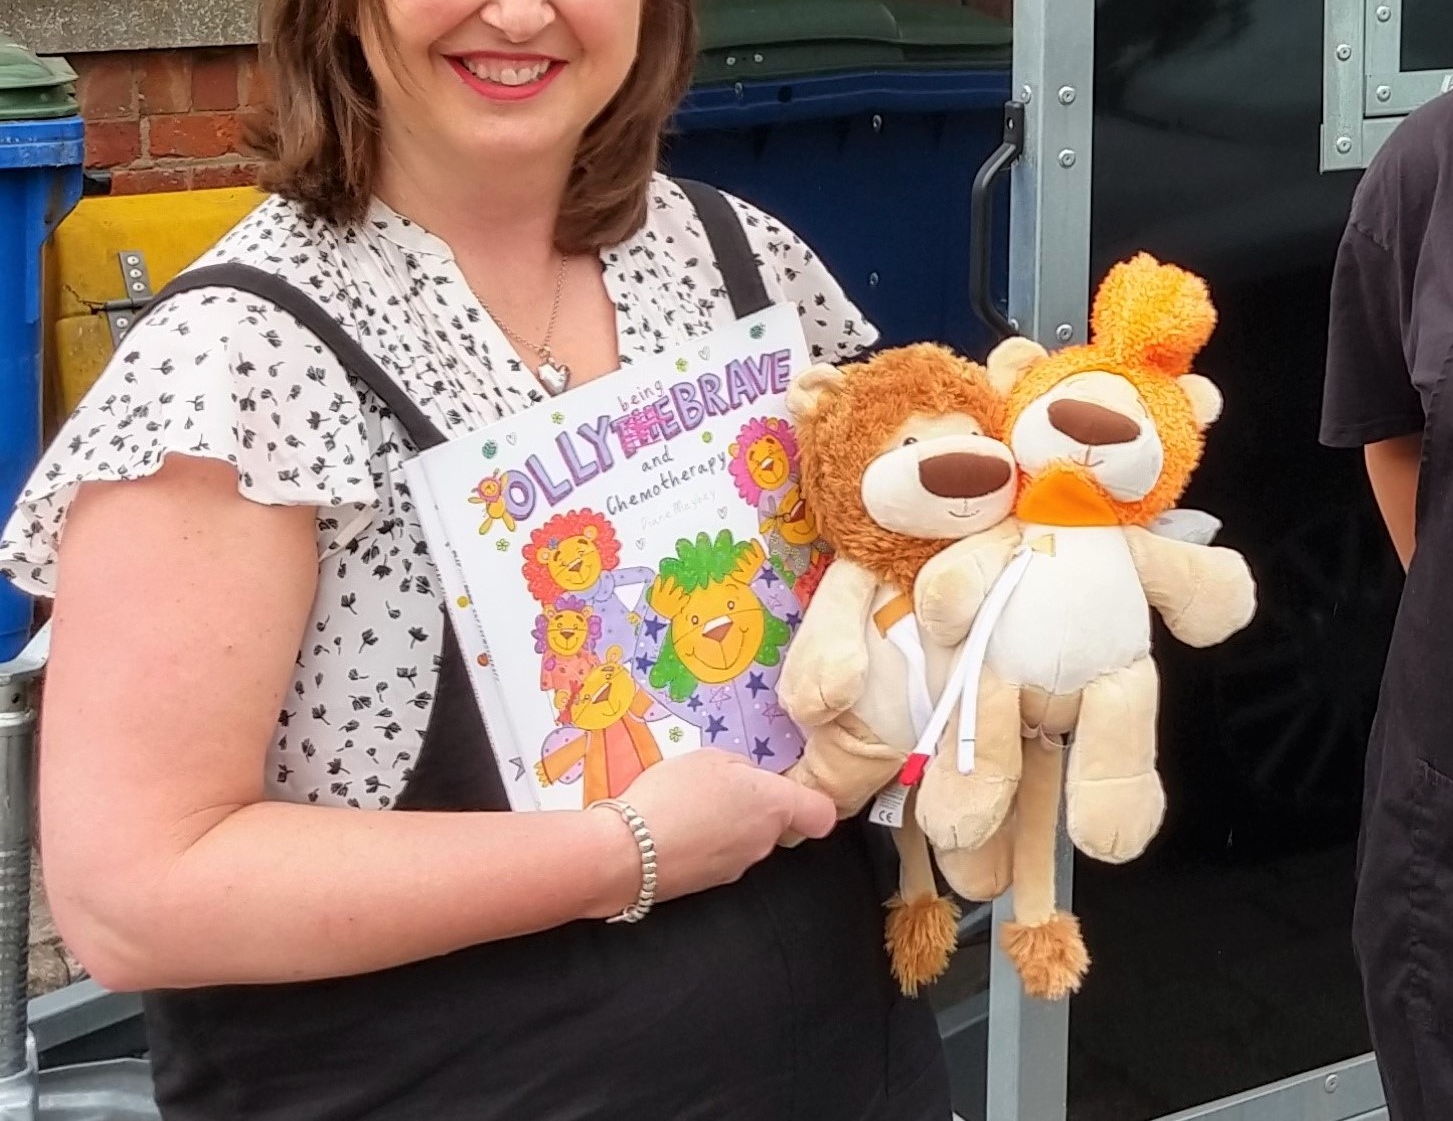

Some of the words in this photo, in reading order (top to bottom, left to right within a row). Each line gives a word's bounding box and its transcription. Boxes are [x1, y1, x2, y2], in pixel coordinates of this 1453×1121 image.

[616, 379, 664, 412] being
[502, 415, 615, 521] OLLY
[669, 348, 792, 432] BRAVE
[641, 444, 675, 473] and
[606, 451, 727, 516] Chemotherapy
